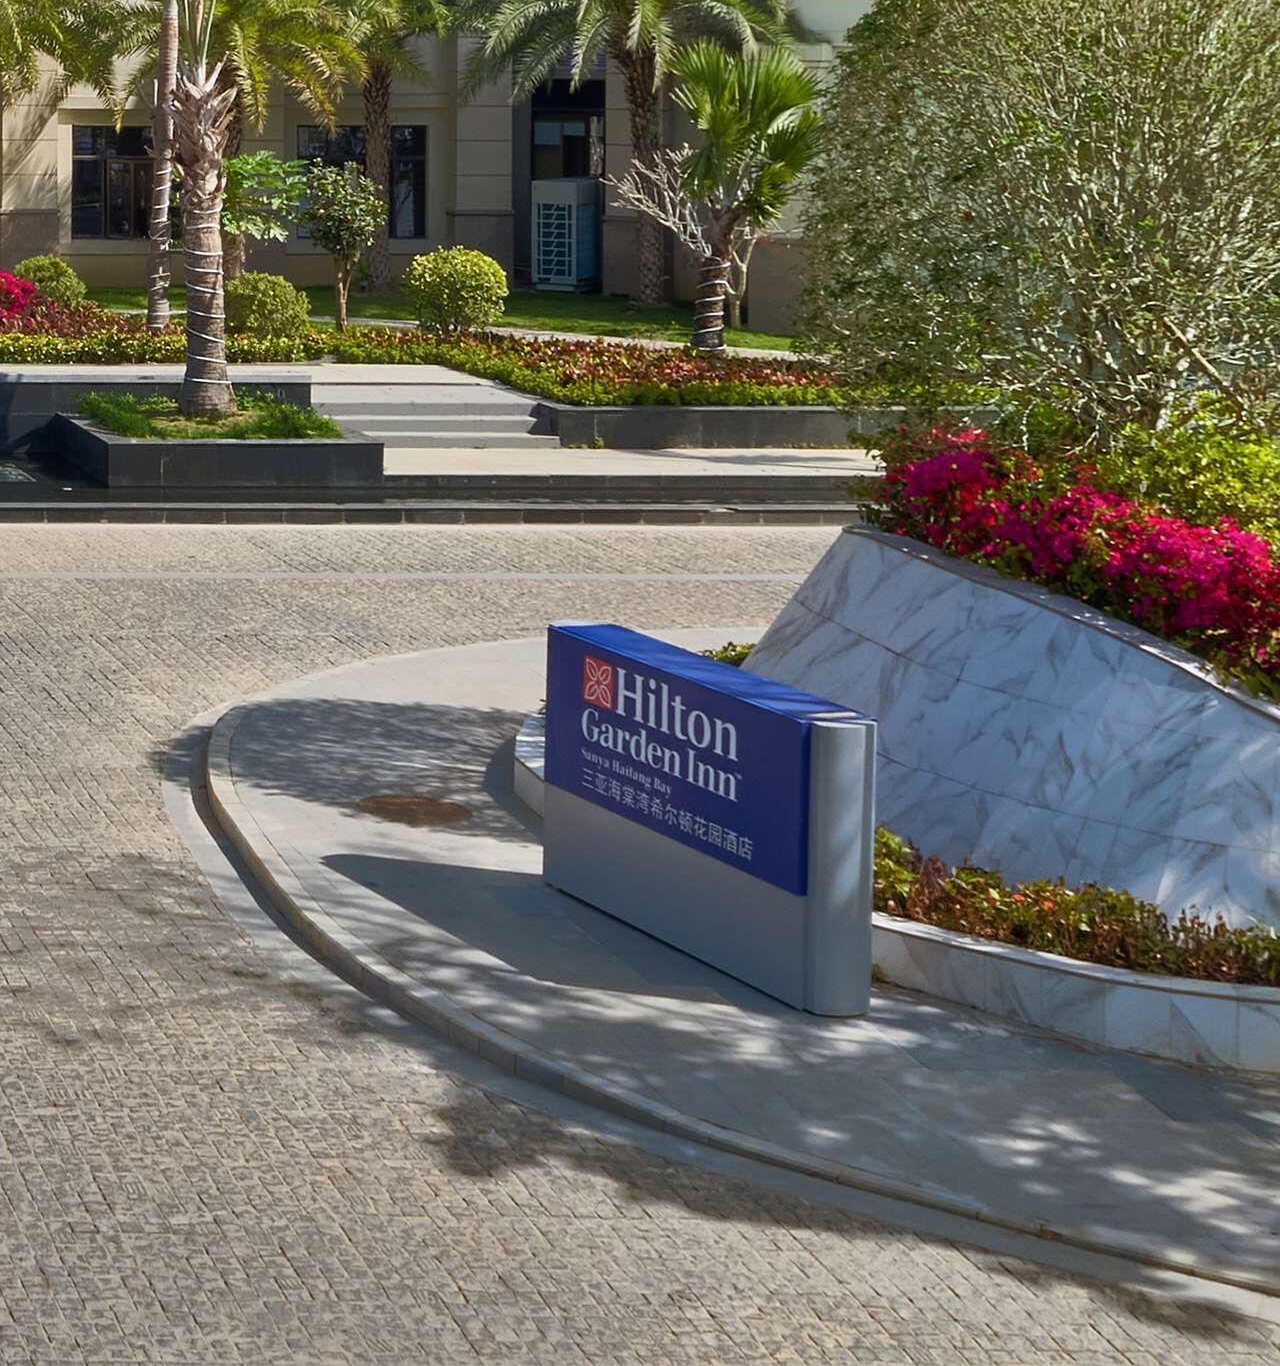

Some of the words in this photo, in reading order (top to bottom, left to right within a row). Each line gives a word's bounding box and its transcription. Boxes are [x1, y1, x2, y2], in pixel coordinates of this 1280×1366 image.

[581, 708, 682, 778] Garden
[686, 747, 738, 802] Inn
[616, 667, 738, 761] Hilton
[581, 767, 753, 860] 三亚海棠湾希尔顿花园酒店
[654, 778, 672, 799] Bay
